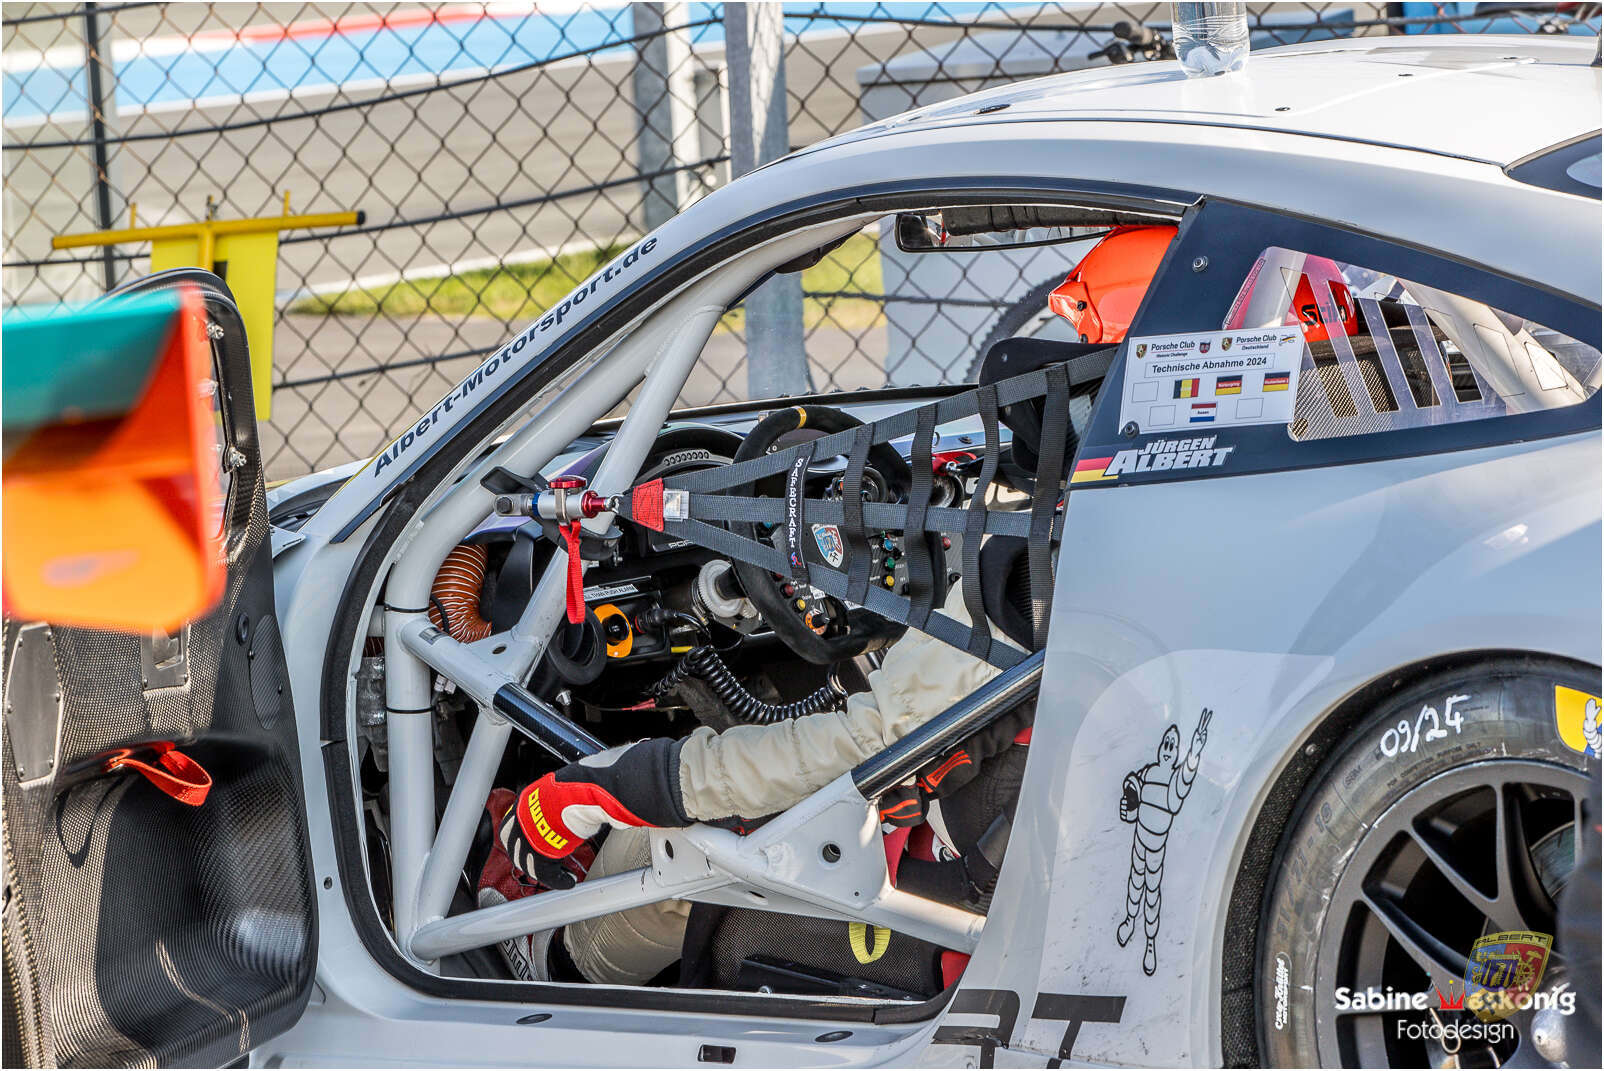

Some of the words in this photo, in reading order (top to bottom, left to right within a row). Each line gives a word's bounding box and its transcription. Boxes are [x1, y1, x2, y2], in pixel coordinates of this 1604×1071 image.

[1151, 341, 1178, 351] Porsche
[1179, 340, 1196, 349] Club
[1235, 336, 1262, 344] Porsche
[1262, 334, 1277, 342] Club
[374, 236, 658, 478] Albert-Motorsport.de
[1152, 362, 1201, 374] Technische
[1202, 359, 1244, 370] Abnahme
[1246, 356, 1267, 367] 2024
[1138, 434, 1218, 455] JÜRGEN
[1103, 446, 1235, 476] ALBERT
[788, 457, 804, 548] SAFECRAFT
[1380, 694, 1472, 757] 09/24
